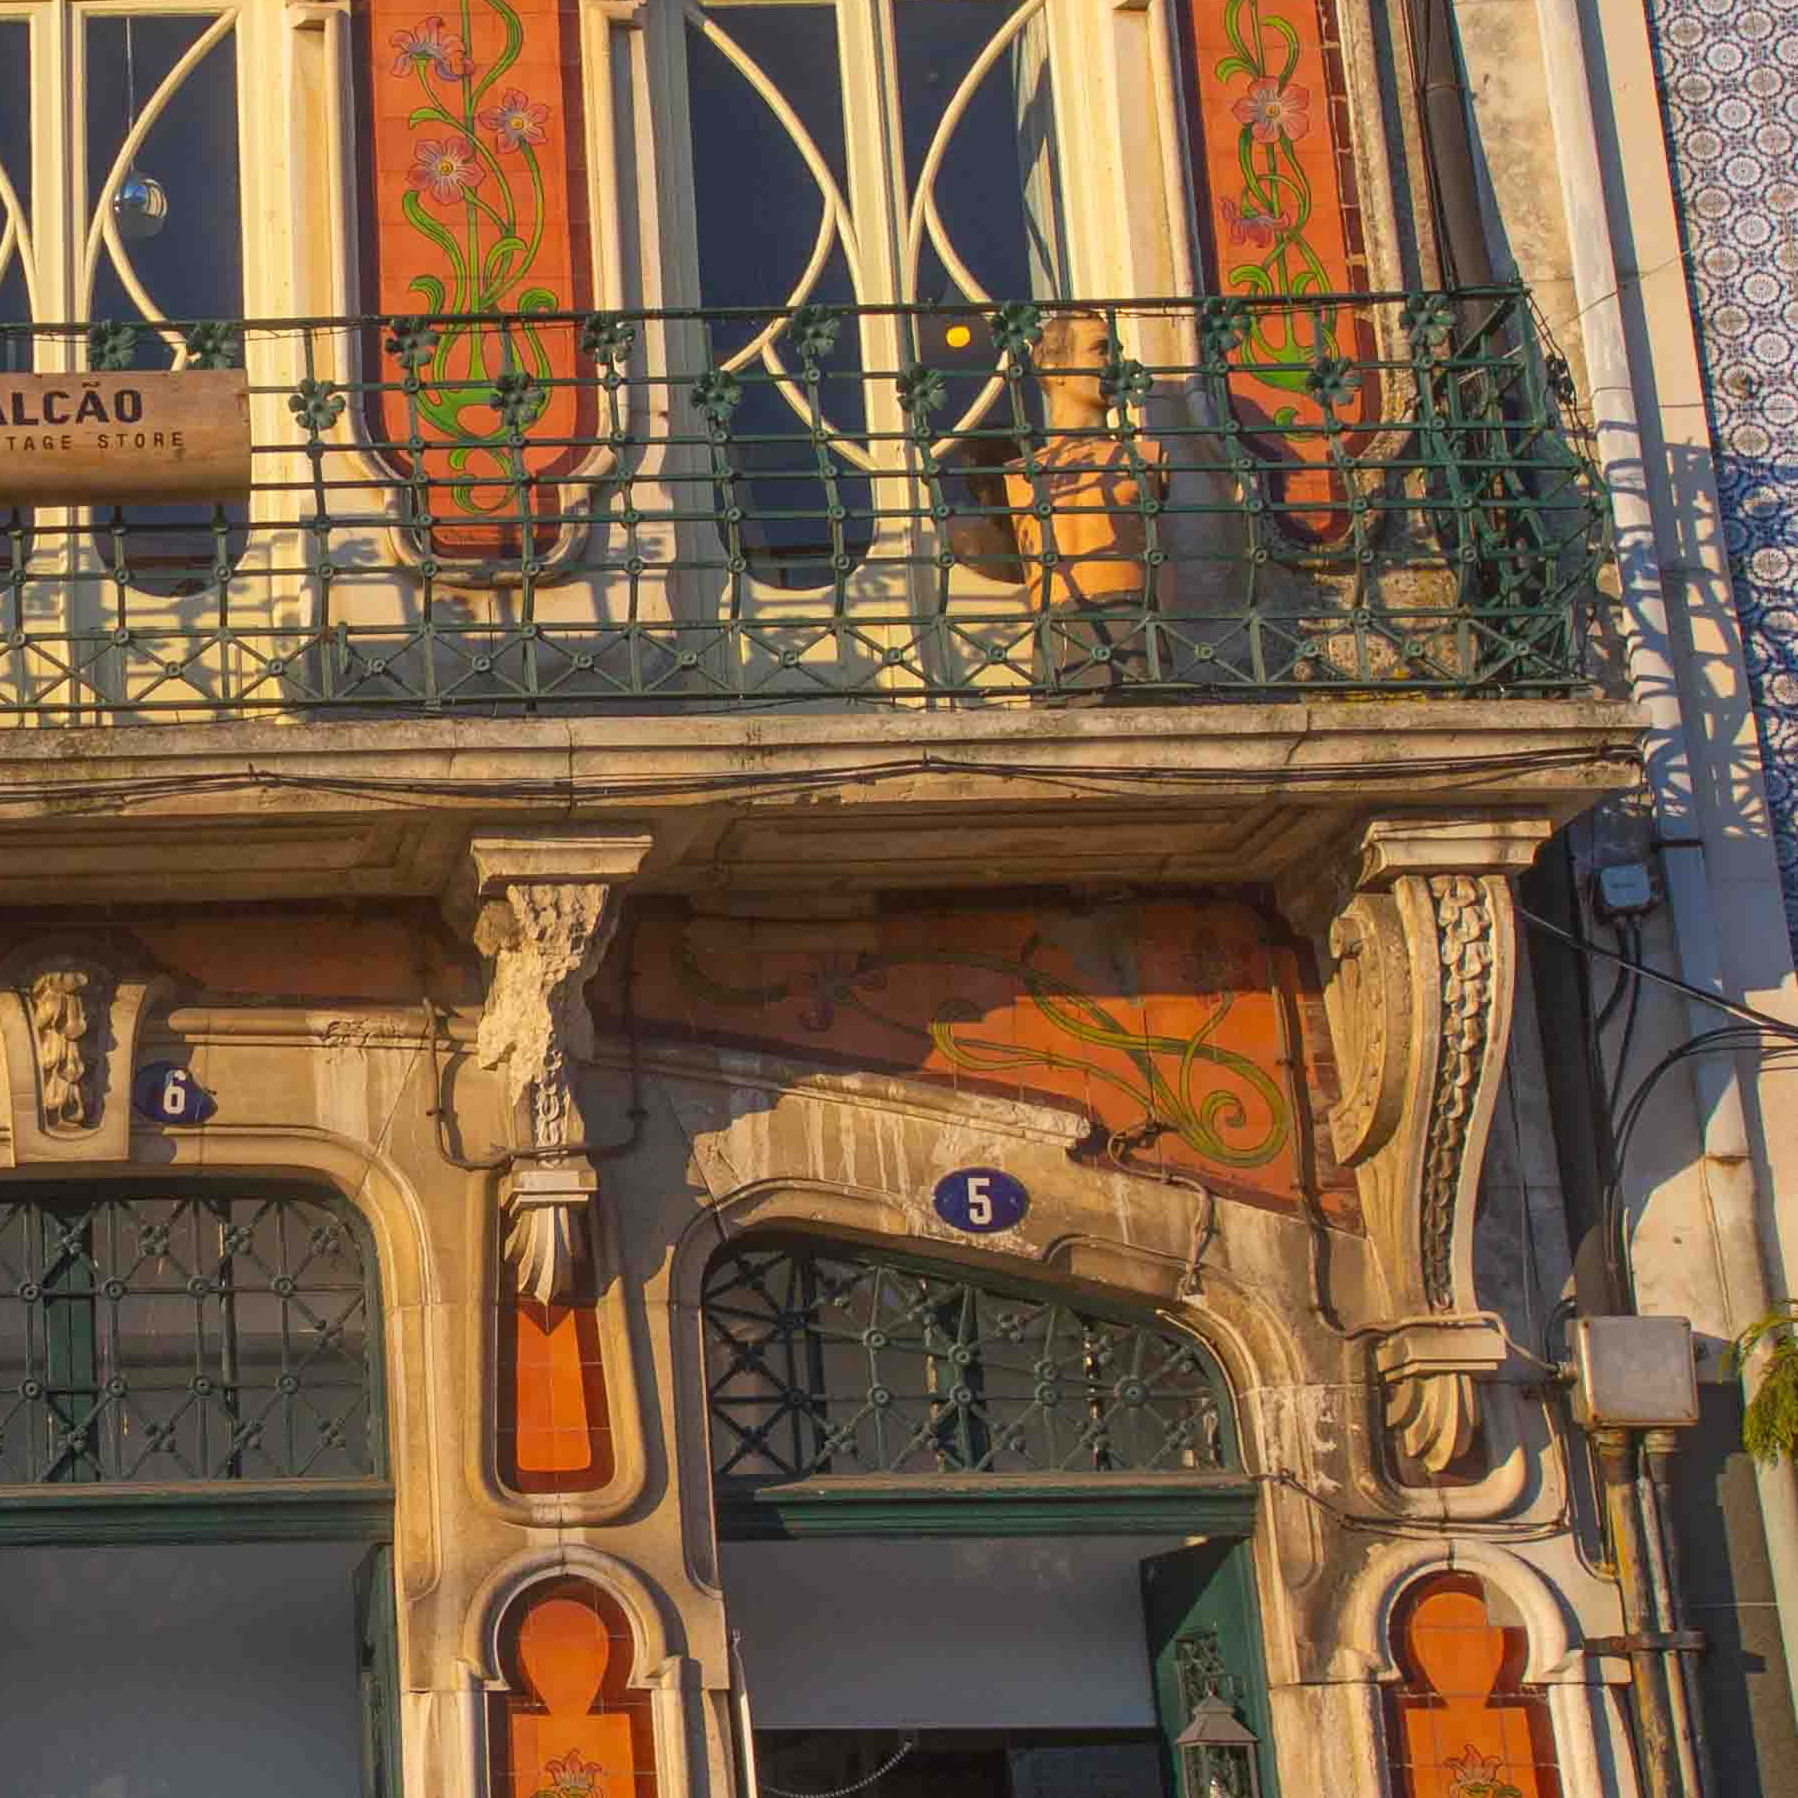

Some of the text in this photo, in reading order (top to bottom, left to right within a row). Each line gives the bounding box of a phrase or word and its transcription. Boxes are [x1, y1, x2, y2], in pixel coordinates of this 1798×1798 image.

[97, 432, 187, 450] STORE
[164, 1069, 187, 1115] 6
[967, 1177, 993, 1224] 5
